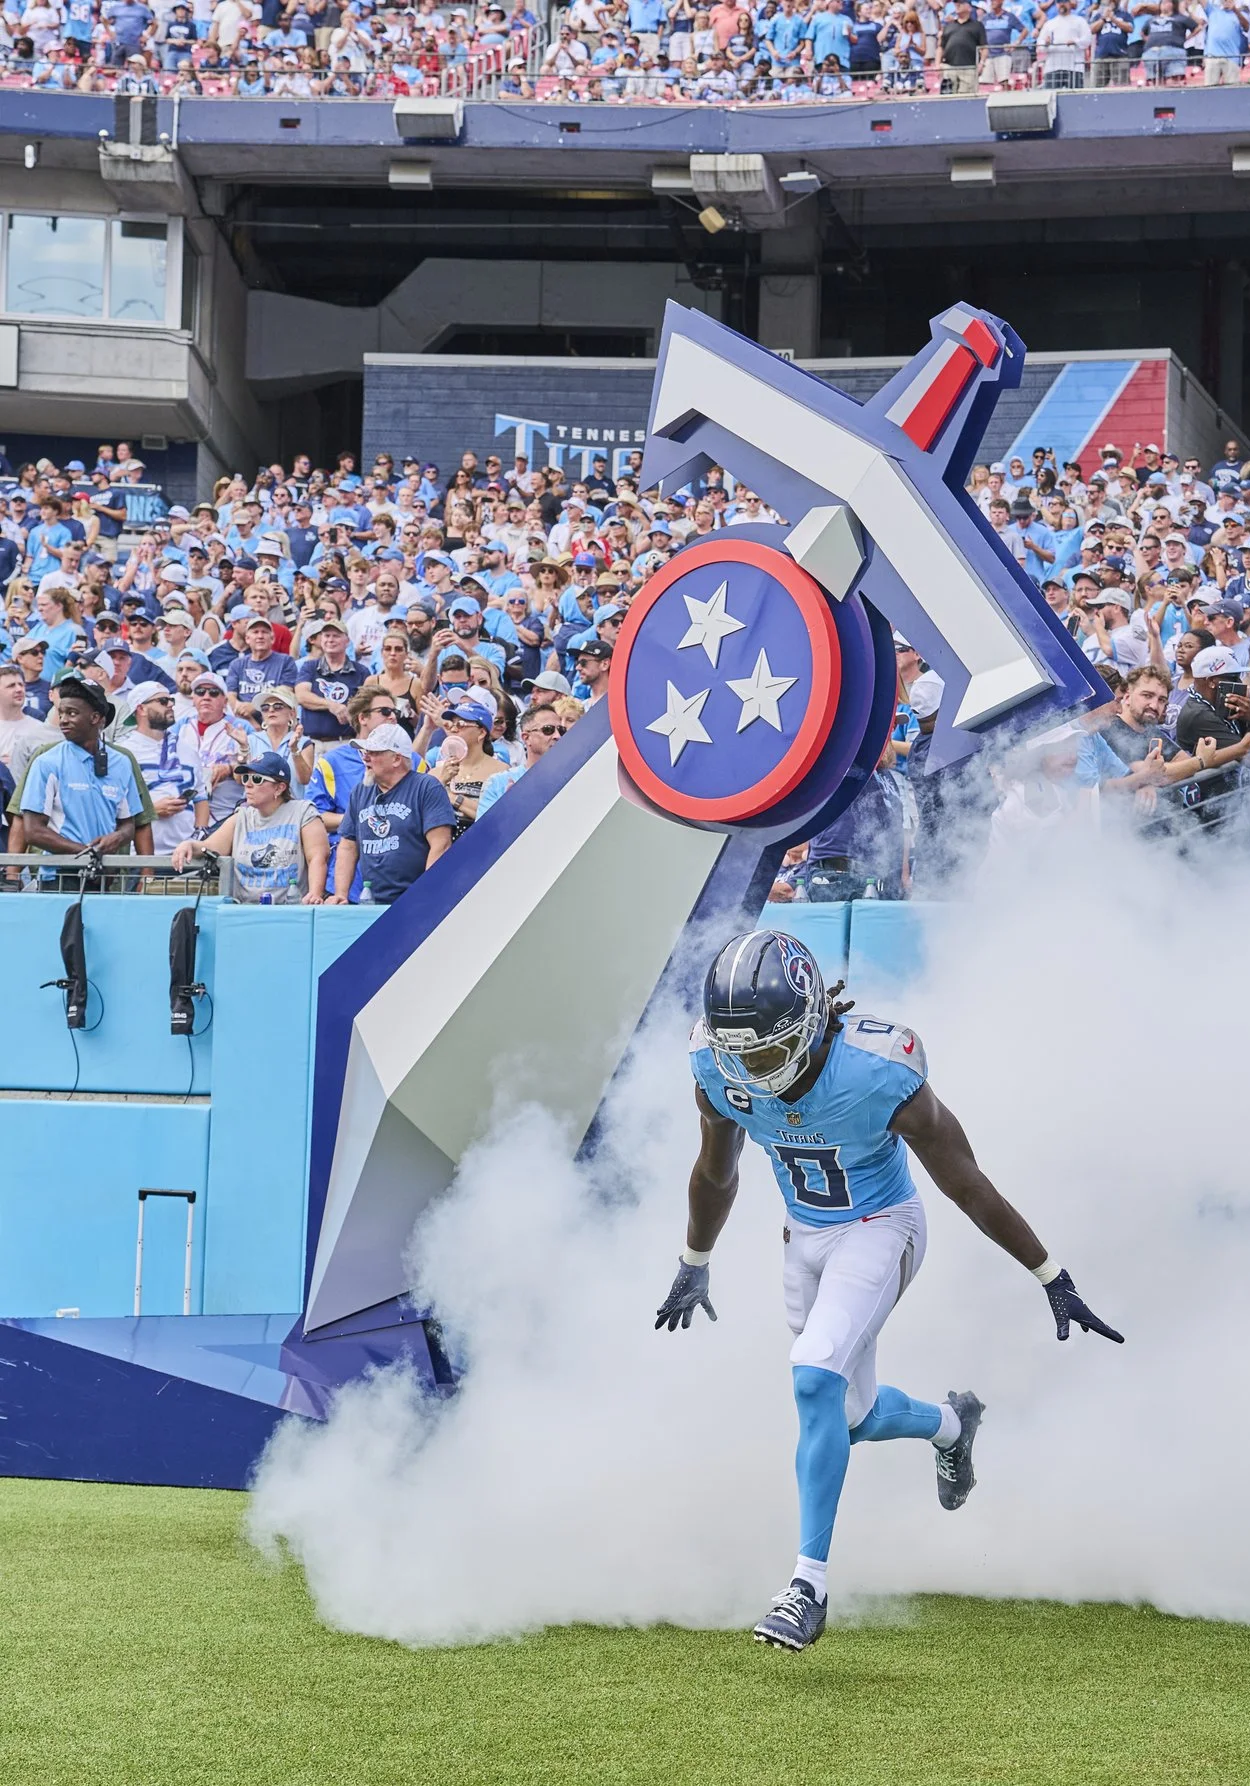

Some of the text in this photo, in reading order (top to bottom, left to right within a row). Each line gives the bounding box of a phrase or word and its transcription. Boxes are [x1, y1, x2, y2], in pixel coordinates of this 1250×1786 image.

[556, 425, 645, 443] TENNES
[776, 1128, 826, 1144] TITANS
[770, 1143, 853, 1210] 0
